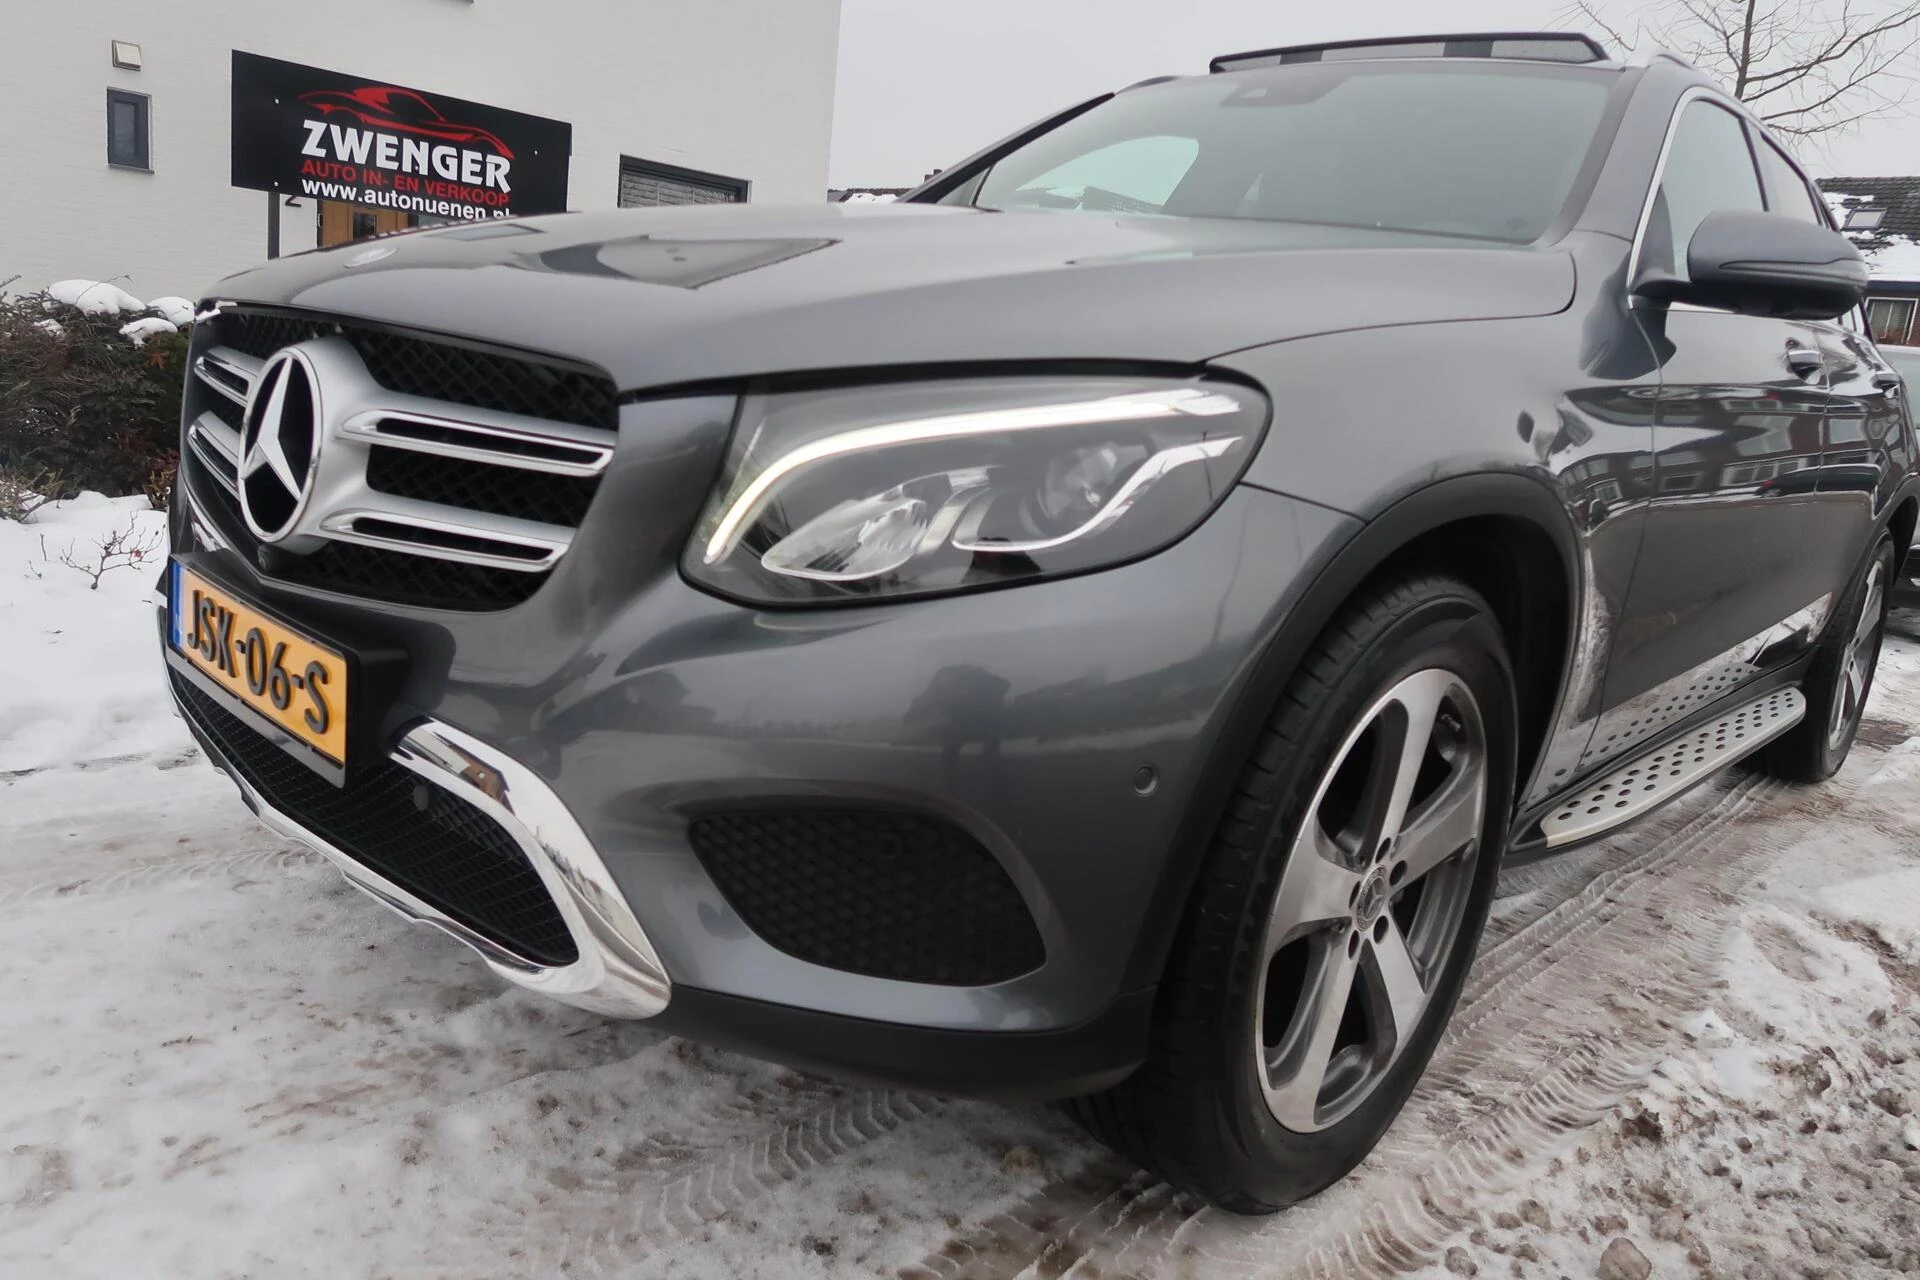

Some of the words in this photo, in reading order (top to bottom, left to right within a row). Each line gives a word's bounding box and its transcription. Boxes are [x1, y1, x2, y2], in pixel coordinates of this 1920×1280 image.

[301, 119, 511, 193] ZWENGER
[301, 160, 357, 182] AUTO
[363, 172, 389, 187] IN-
[394, 174, 419, 193] EN
[424, 180, 510, 207] VERKOOP
[301, 179, 511, 219] www.autonuenenn
[187, 589, 329, 735] JSK-06-S
